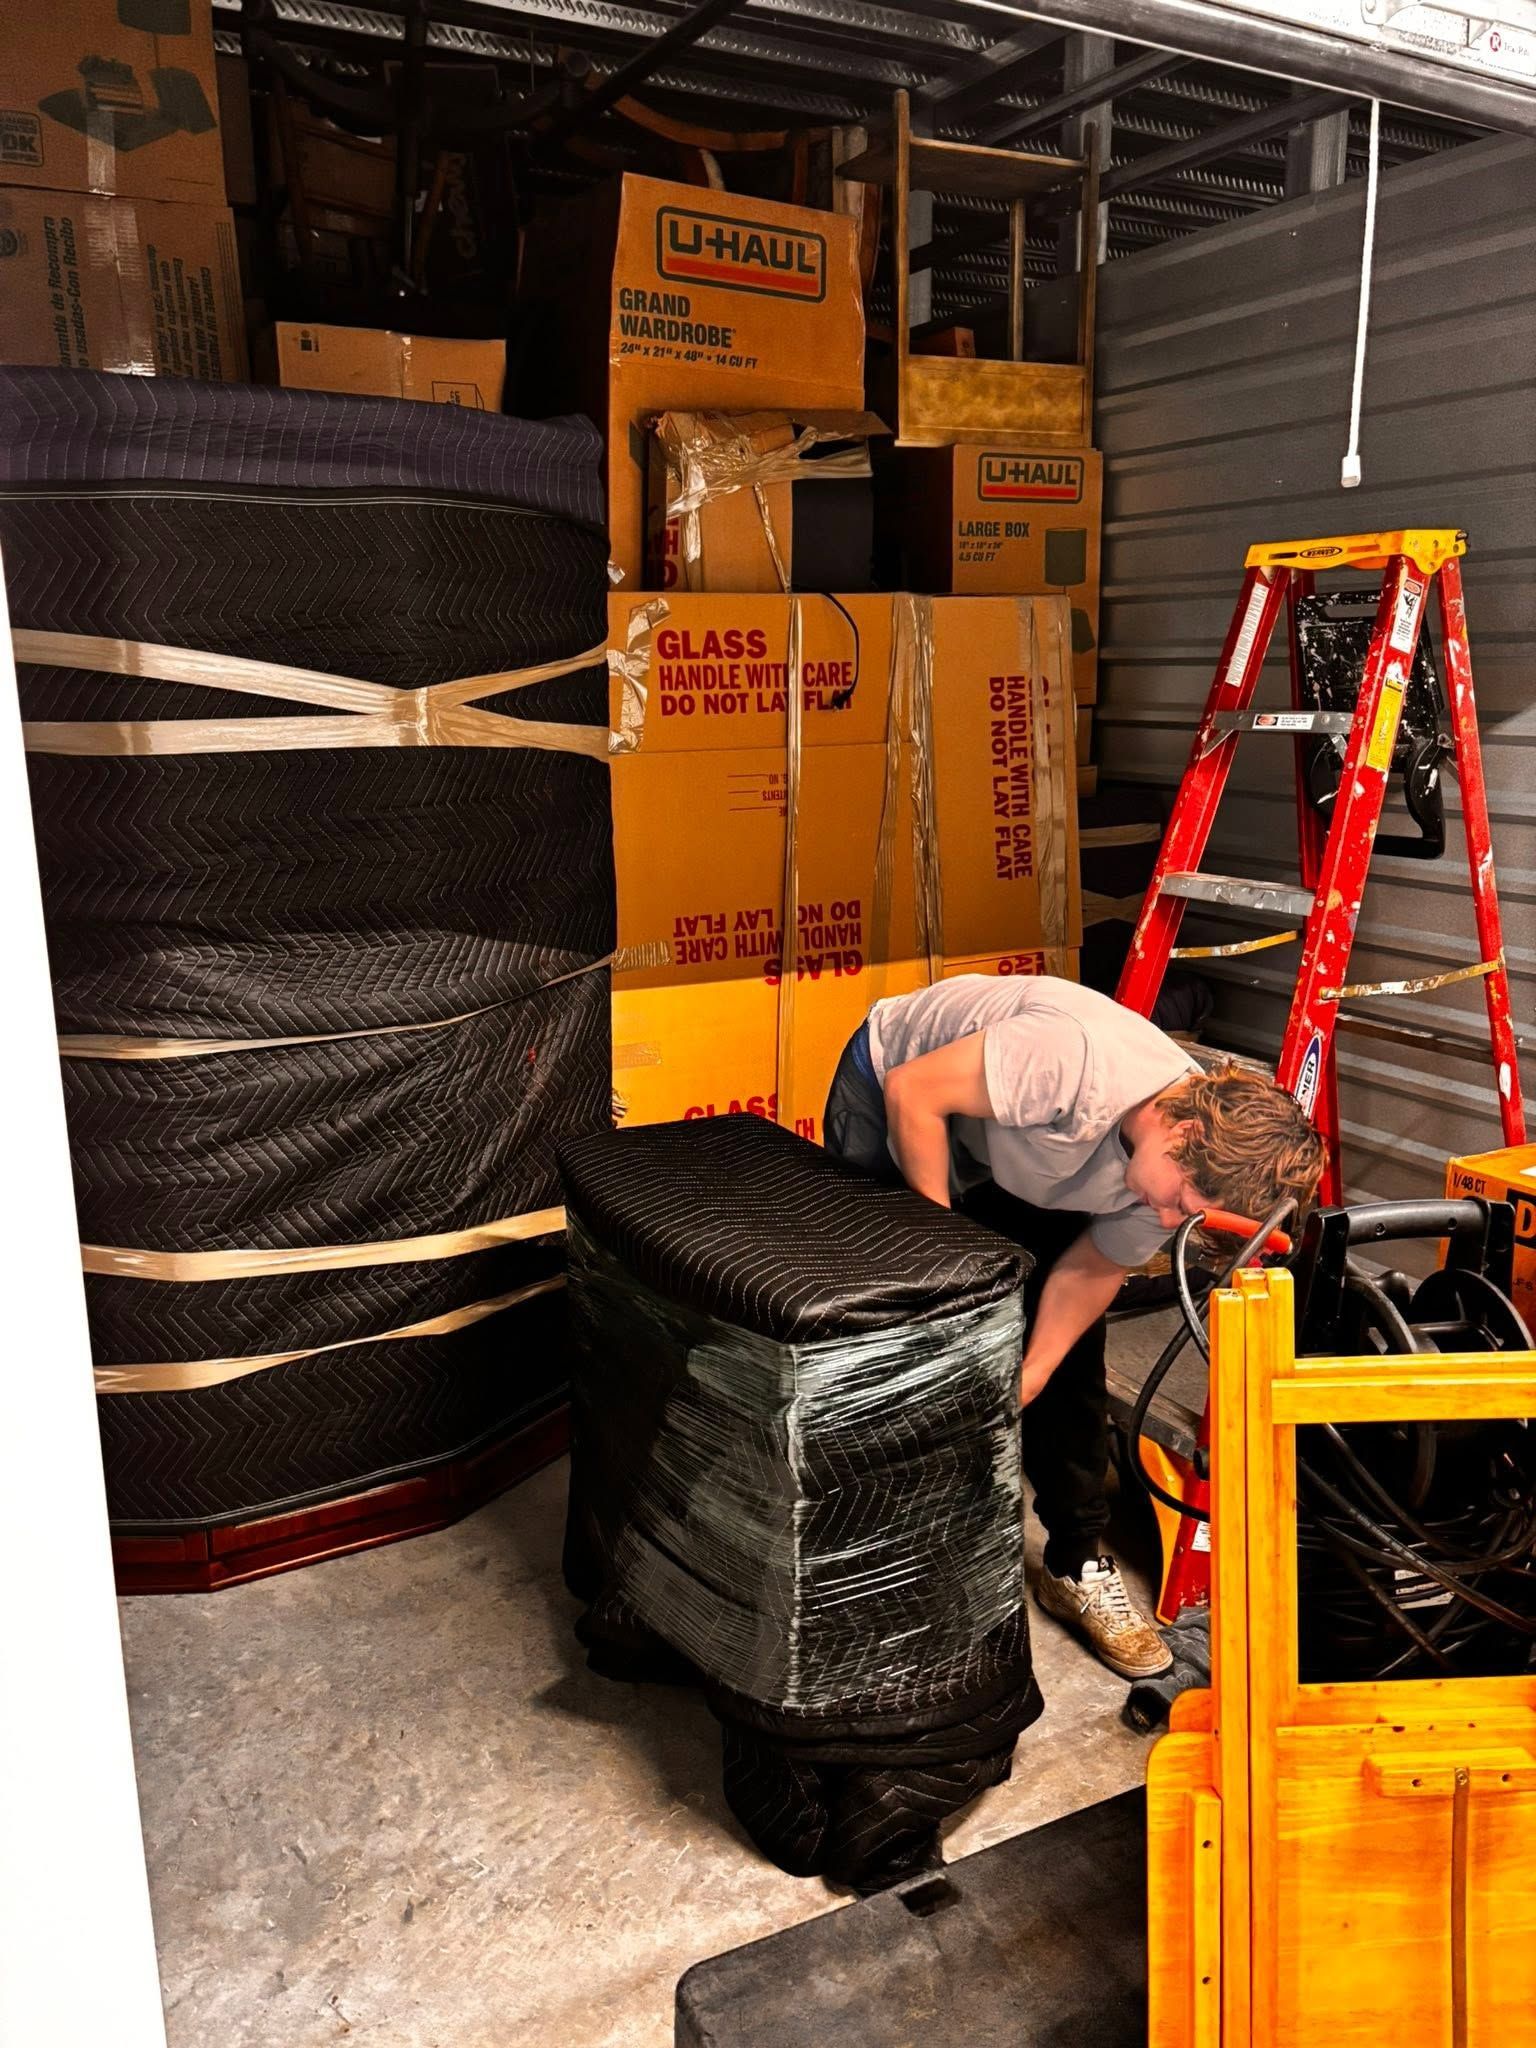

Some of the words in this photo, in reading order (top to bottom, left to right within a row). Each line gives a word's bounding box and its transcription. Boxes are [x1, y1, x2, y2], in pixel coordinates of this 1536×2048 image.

[619, 287, 691, 317] GRAND
[620, 314, 733, 348] WARDROBE
[715, 354, 726, 365] 14
[729, 355, 743, 368] CU
[745, 358, 758, 369] FT
[958, 522, 1000, 537] LARGE
[1005, 522, 1030, 537] BOX
[657, 629, 767, 660] GLASS
[659, 664, 740, 691] HANDLE
[802, 661, 853, 688] CARE
[661, 694, 696, 716] DO
[704, 692, 749, 715] NOT
[804, 689, 852, 712] FL
[989, 677, 1006, 712] DO
[1007, 676, 1027, 760] HANDLE
[991, 720, 1008, 768] NOT
[762, 790, 788, 801] TENTS
[993, 776, 1010, 819] LAY
[1010, 763, 1030, 817] WITH
[995, 825, 1013, 881] FLAT
[1012, 823, 1033, 878] CARE
[673, 912, 726, 938] FLAT
[733, 908, 773, 932] LAY
[798, 904, 823, 924] NO
[830, 900, 861, 921] DO
[676, 936, 728, 965] CARE
[735, 929, 782, 959] WITH
[800, 922, 862, 951] HANDL
[1474, 1179, 1487, 1195] CT
